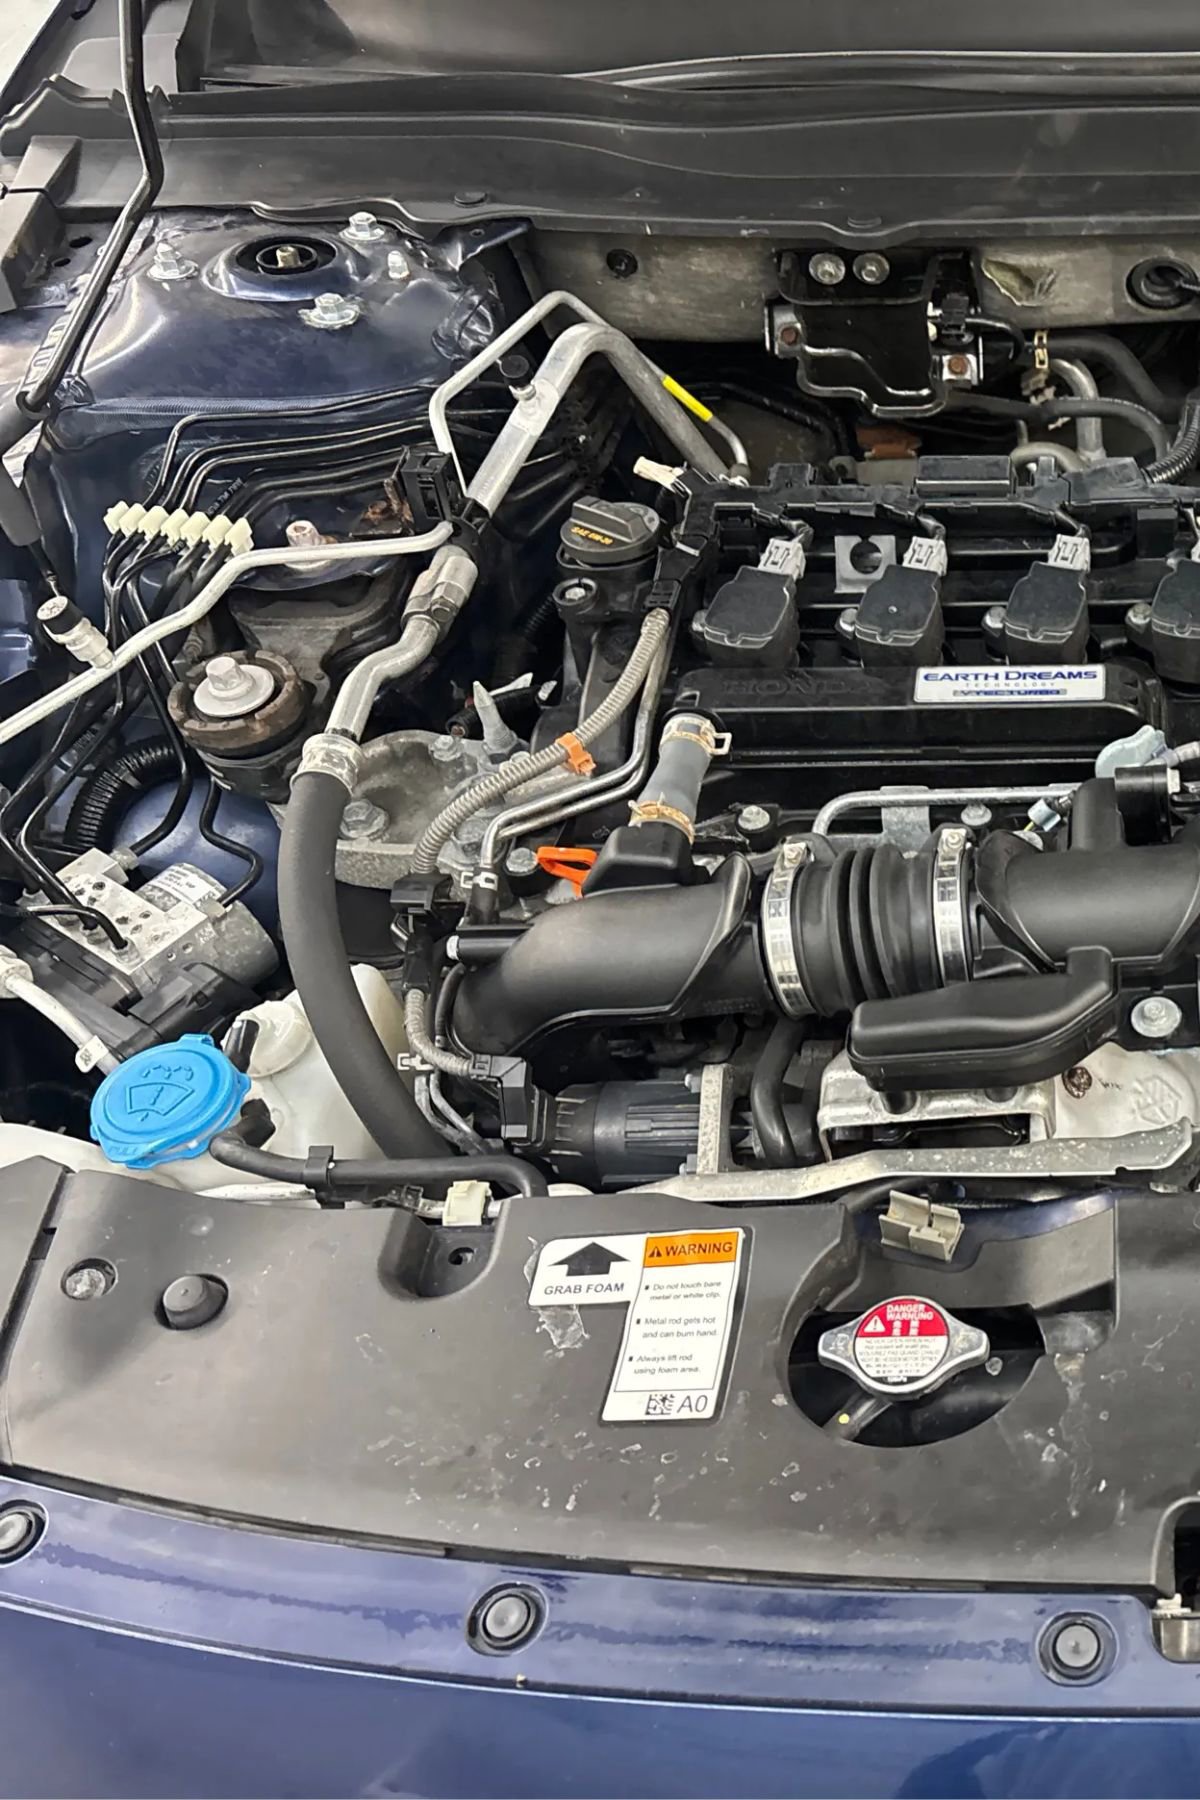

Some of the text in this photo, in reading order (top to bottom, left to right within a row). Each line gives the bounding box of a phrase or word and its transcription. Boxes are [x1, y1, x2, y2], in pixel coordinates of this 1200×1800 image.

[924, 671, 1097, 682] EARTH DREAMS
[722, 680, 886, 695] HONDA
[665, 1242, 733, 1257] WARNING
[544, 1283, 624, 1295] GRAB FOAM
[886, 1304, 926, 1312] DANGER
[644, 1316, 716, 1326] Metal rod gets hot
[636, 1355, 666, 1363] Always
[634, 1367, 656, 1375] using
[676, 1394, 708, 1413] A0
